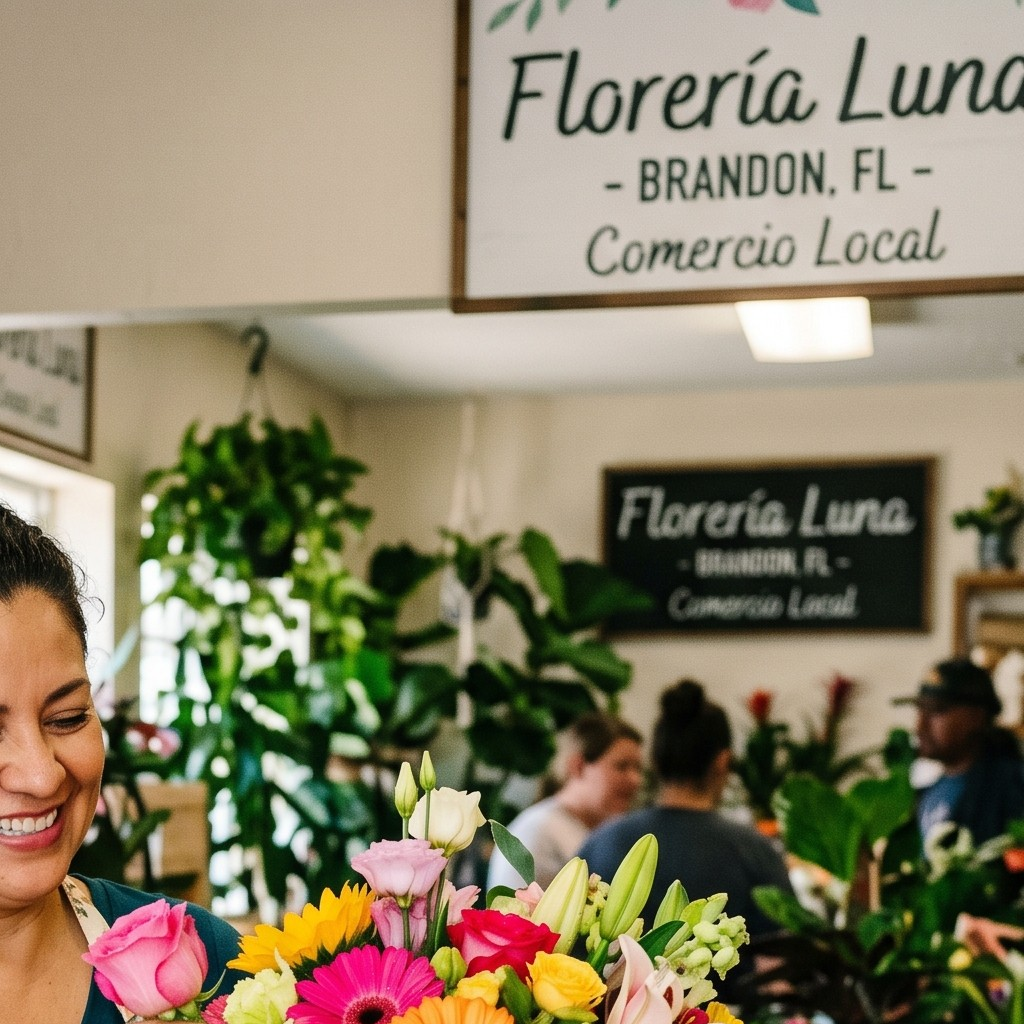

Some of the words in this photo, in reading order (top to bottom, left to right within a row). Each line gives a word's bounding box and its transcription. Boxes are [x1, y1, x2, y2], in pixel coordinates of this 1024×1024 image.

[502, 48, 818, 141] Florería
[838, 35, 1024, 123] Luna
[640, 150, 836, 201] BRANDON,
[853, 148, 896, 192] FL
[585, 222, 796, 276] Comercio
[814, 207, 947, 267] Local
[617, 486, 793, 540] Florería
[797, 483, 916, 537] Luna
